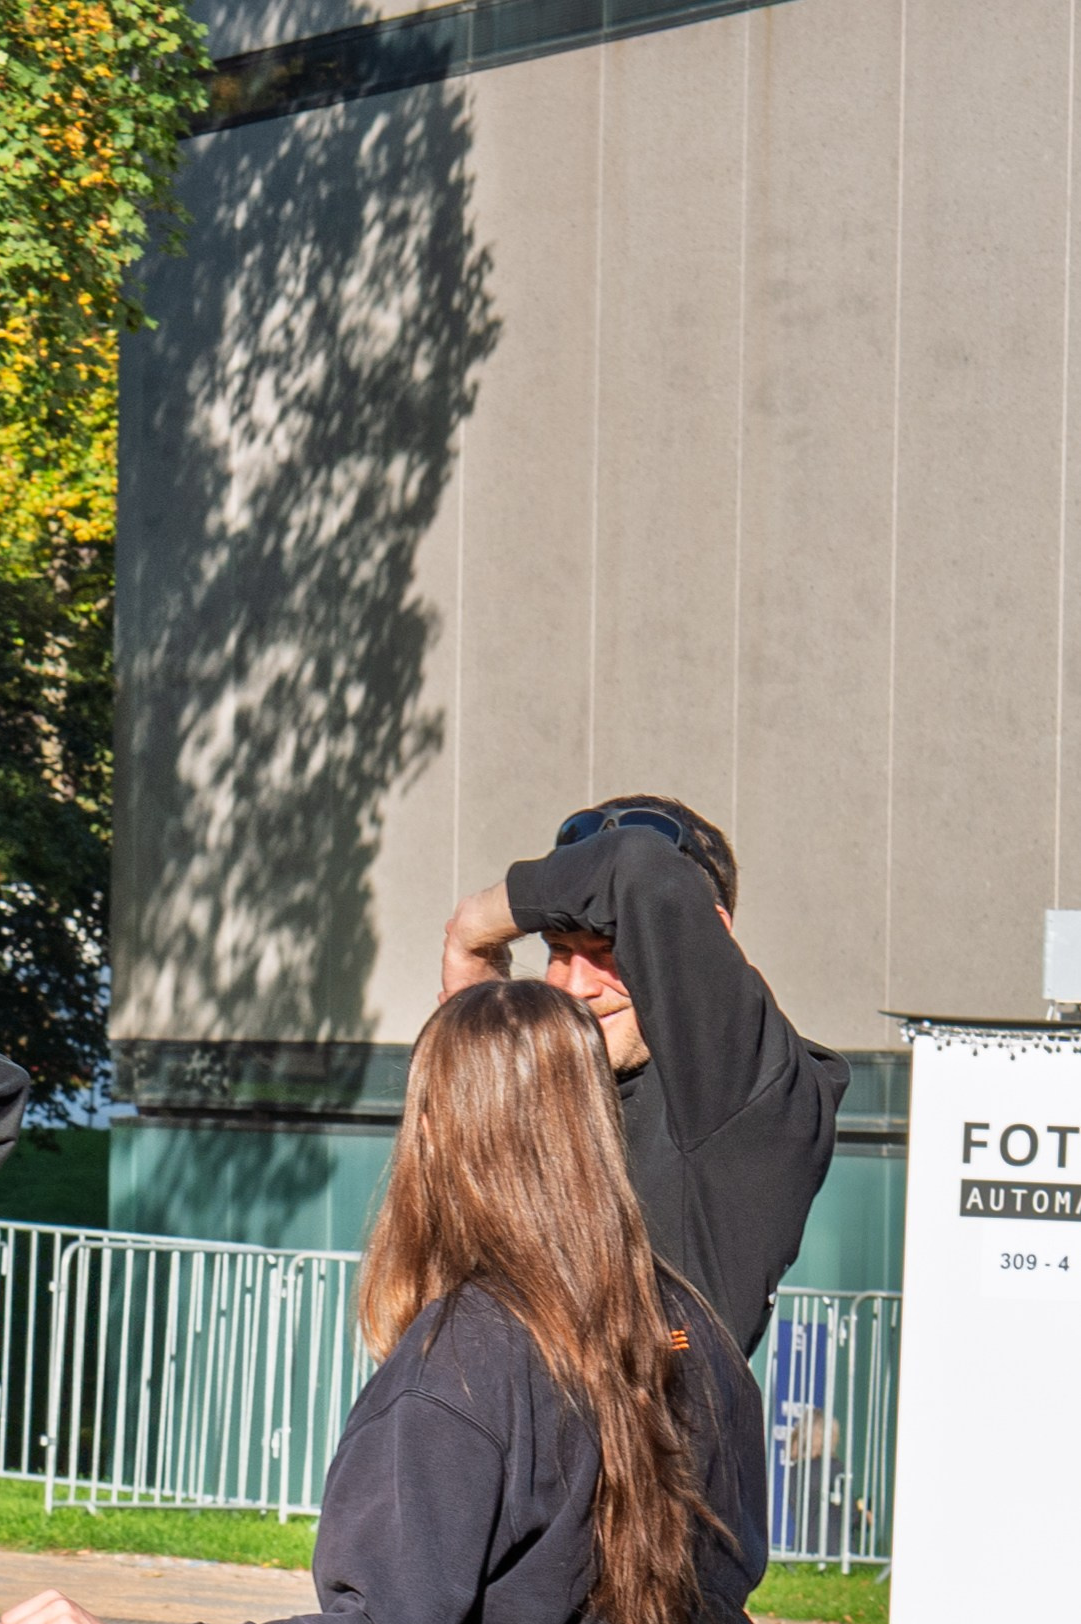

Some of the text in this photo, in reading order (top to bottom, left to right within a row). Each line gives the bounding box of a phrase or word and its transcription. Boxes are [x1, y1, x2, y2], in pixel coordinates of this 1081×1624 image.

[962, 1121, 1081, 1169] FOT
[1000, 1253, 1037, 1270] 309
[1058, 1256, 1070, 1271] 4
